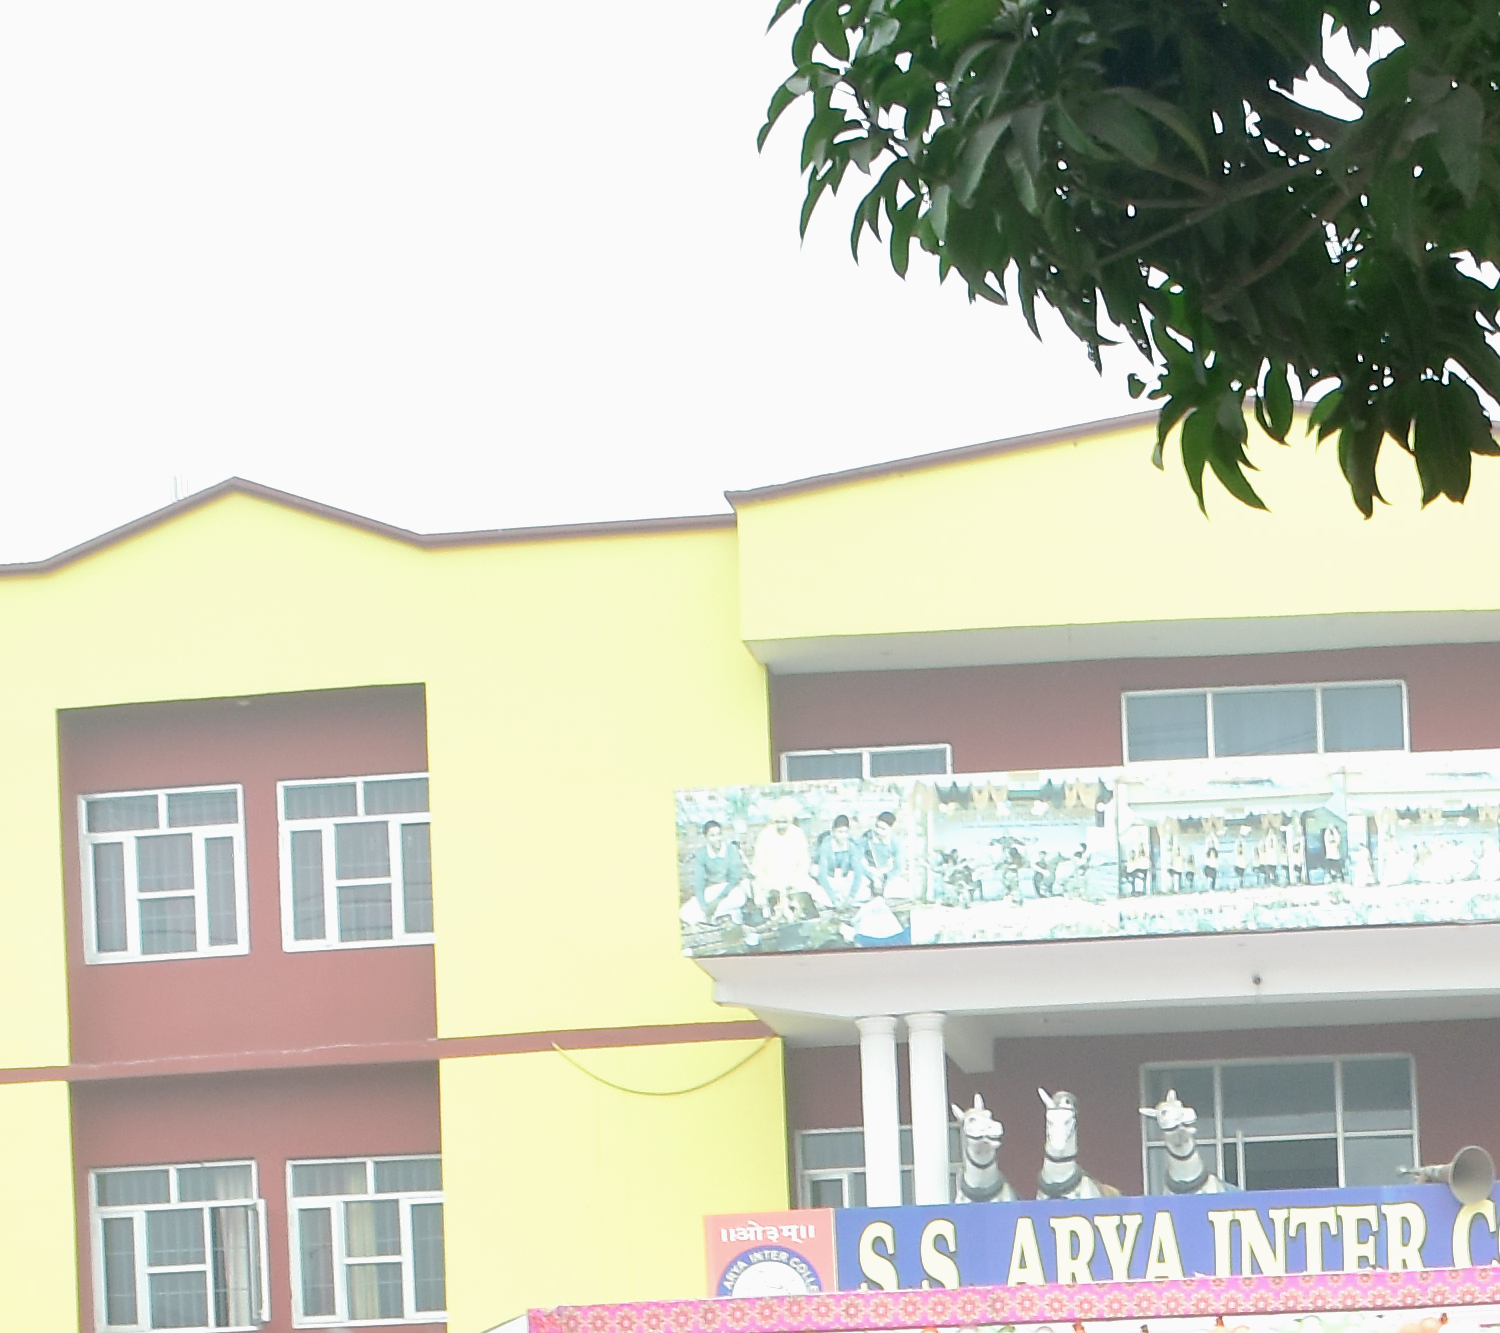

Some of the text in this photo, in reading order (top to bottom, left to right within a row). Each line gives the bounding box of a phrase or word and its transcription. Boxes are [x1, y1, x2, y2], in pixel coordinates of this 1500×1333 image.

[748, 1250, 790, 1263] INTER
[789, 1257, 820, 1294] COLLE
[1007, 1210, 1184, 1287] ARYA
[1208, 1201, 1427, 1278] INTER
